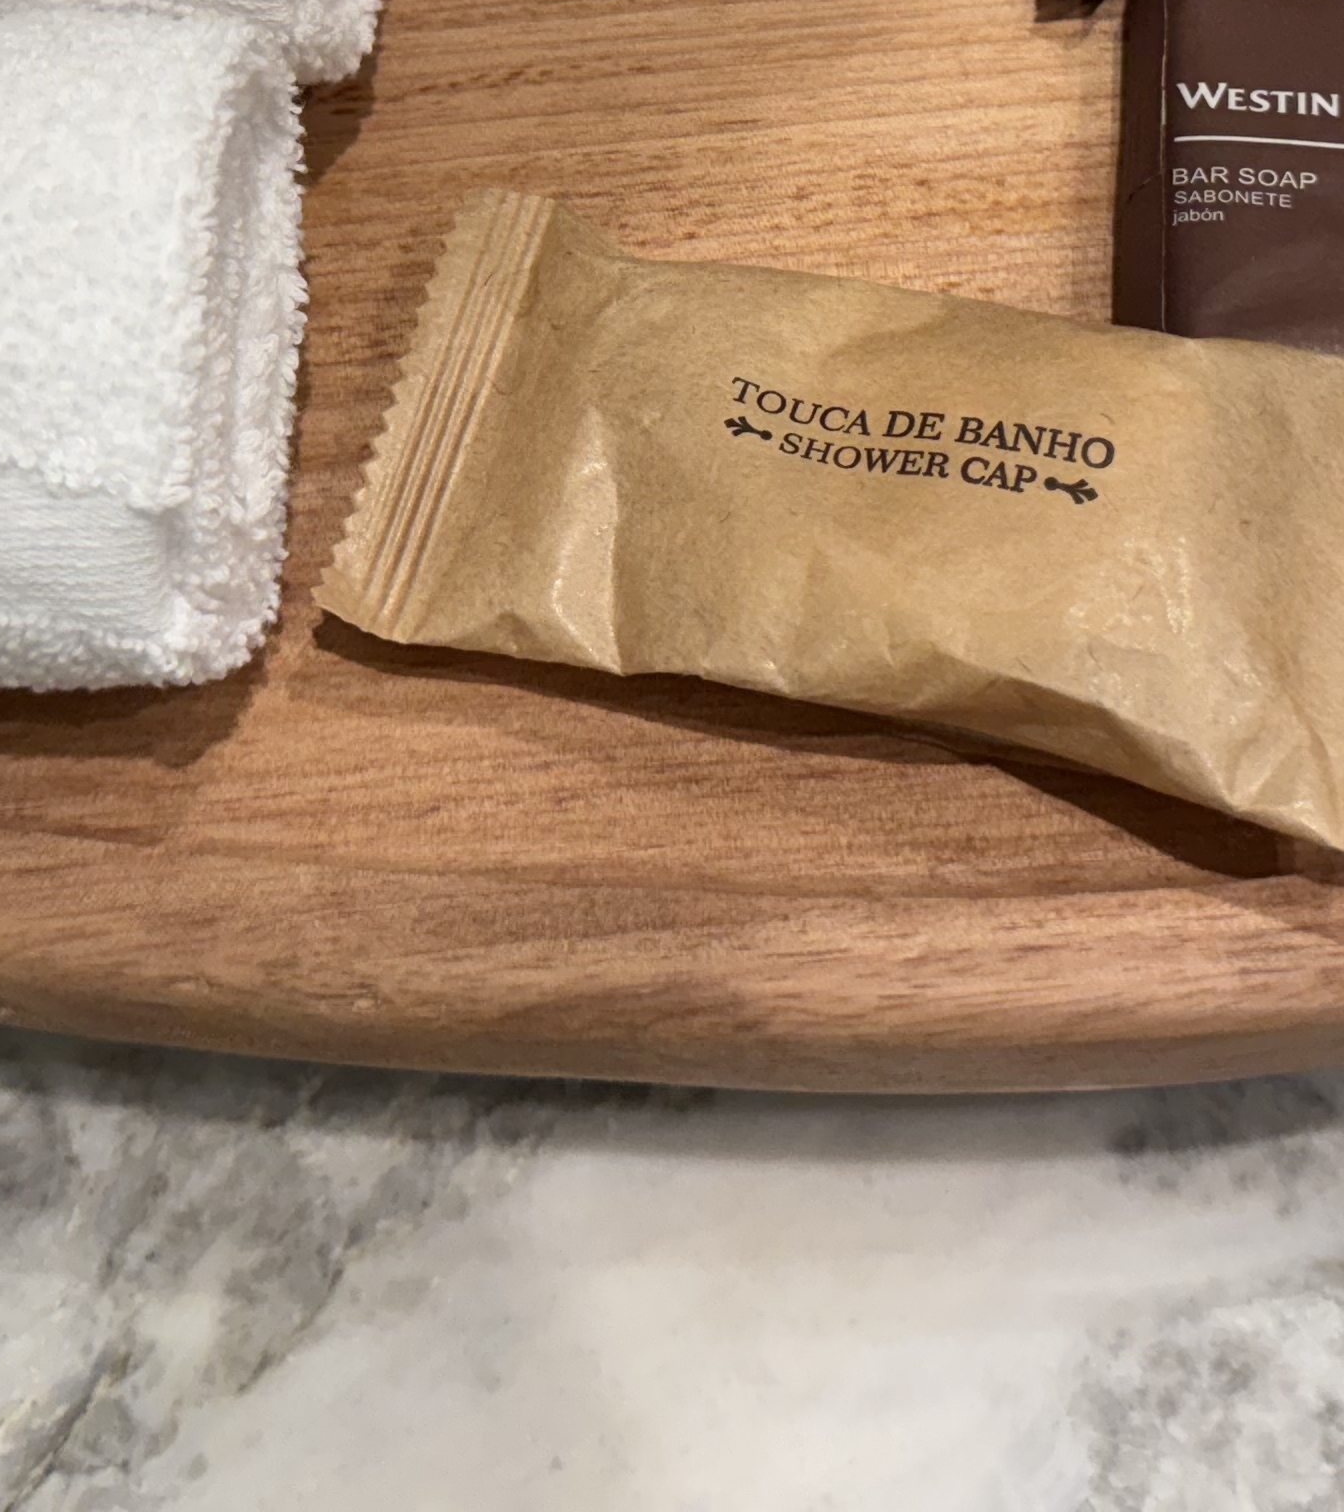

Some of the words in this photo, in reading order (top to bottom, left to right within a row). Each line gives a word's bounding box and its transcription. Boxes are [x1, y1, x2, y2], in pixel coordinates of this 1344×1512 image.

[1176, 81, 1340, 117] WESTIN
[1172, 166, 1229, 185] BAR
[1237, 167, 1318, 190] SOAP
[1173, 189, 1292, 208] SABONETE
[1171, 207, 1225, 226] jabón
[731, 376, 871, 437] TOUCA
[882, 410, 945, 441] DE
[954, 415, 1115, 470] BANHO
[778, 431, 949, 479] SHOWER
[959, 456, 1038, 493] CAP
